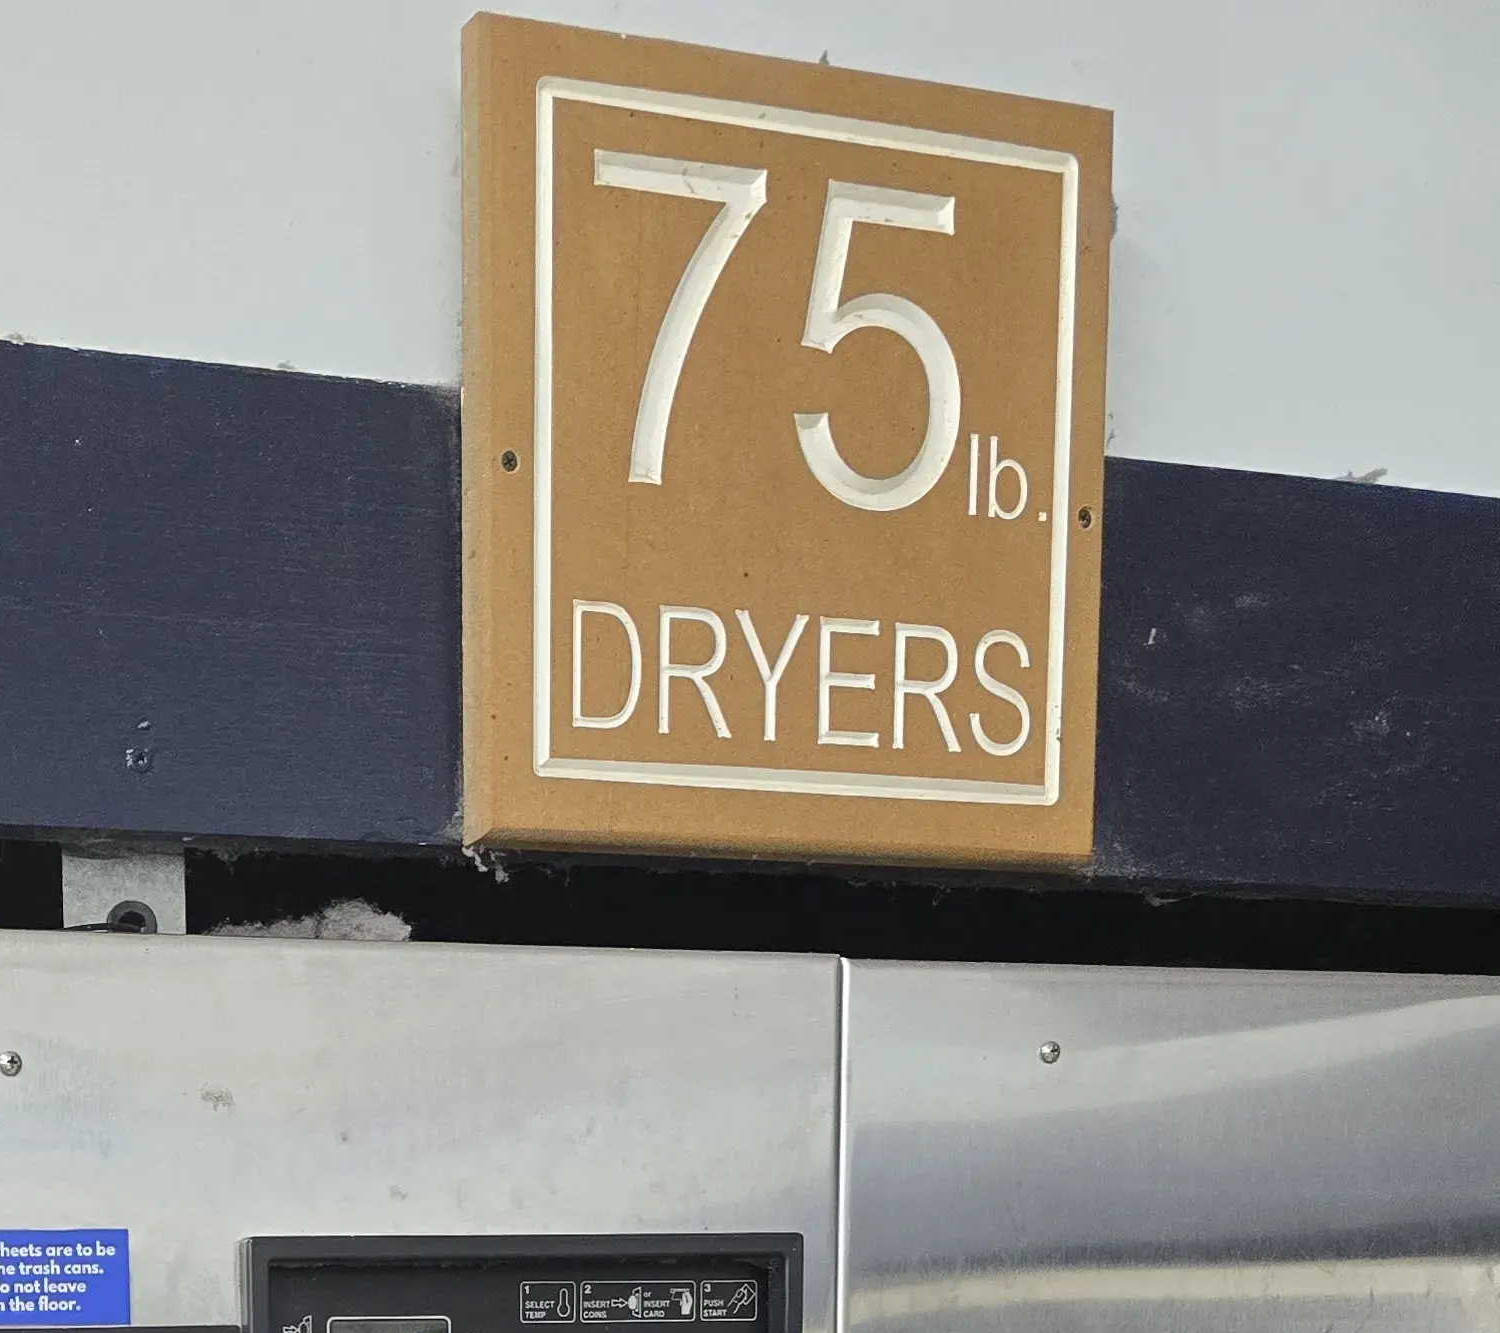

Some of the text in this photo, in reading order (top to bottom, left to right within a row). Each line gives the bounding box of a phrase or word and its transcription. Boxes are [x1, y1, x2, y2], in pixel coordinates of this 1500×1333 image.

[593, 149, 1047, 522] 75 lb.
[572, 600, 1031, 757] DRYERS
[46, 1245, 73, 1257] are
[76, 1243, 92, 1256] to
[96, 1241, 115, 1256] be
[19, 1260, 60, 1275] trash
[64, 1262, 104, 1275] cans.
[14, 1280, 40, 1293] not
[44, 1278, 86, 1293] leave
[584, 1285, 592, 1294] 2
[704, 1284, 711, 1292] 3
[524, 1286, 530, 1294] 1
[9, 1297, 34, 1312] the
[38, 1295, 81, 1311] floor.
[525, 1301, 554, 1309] SELECT
[583, 1301, 610, 1309] INSERT
[643, 1300, 670, 1308] INSERT
[703, 1299, 724, 1307] PUSH
[525, 1311, 546, 1319] TEMP
[583, 1311, 607, 1319] COINS
[643, 1310, 665, 1318] CARD
[703, 1309, 727, 1317] START
